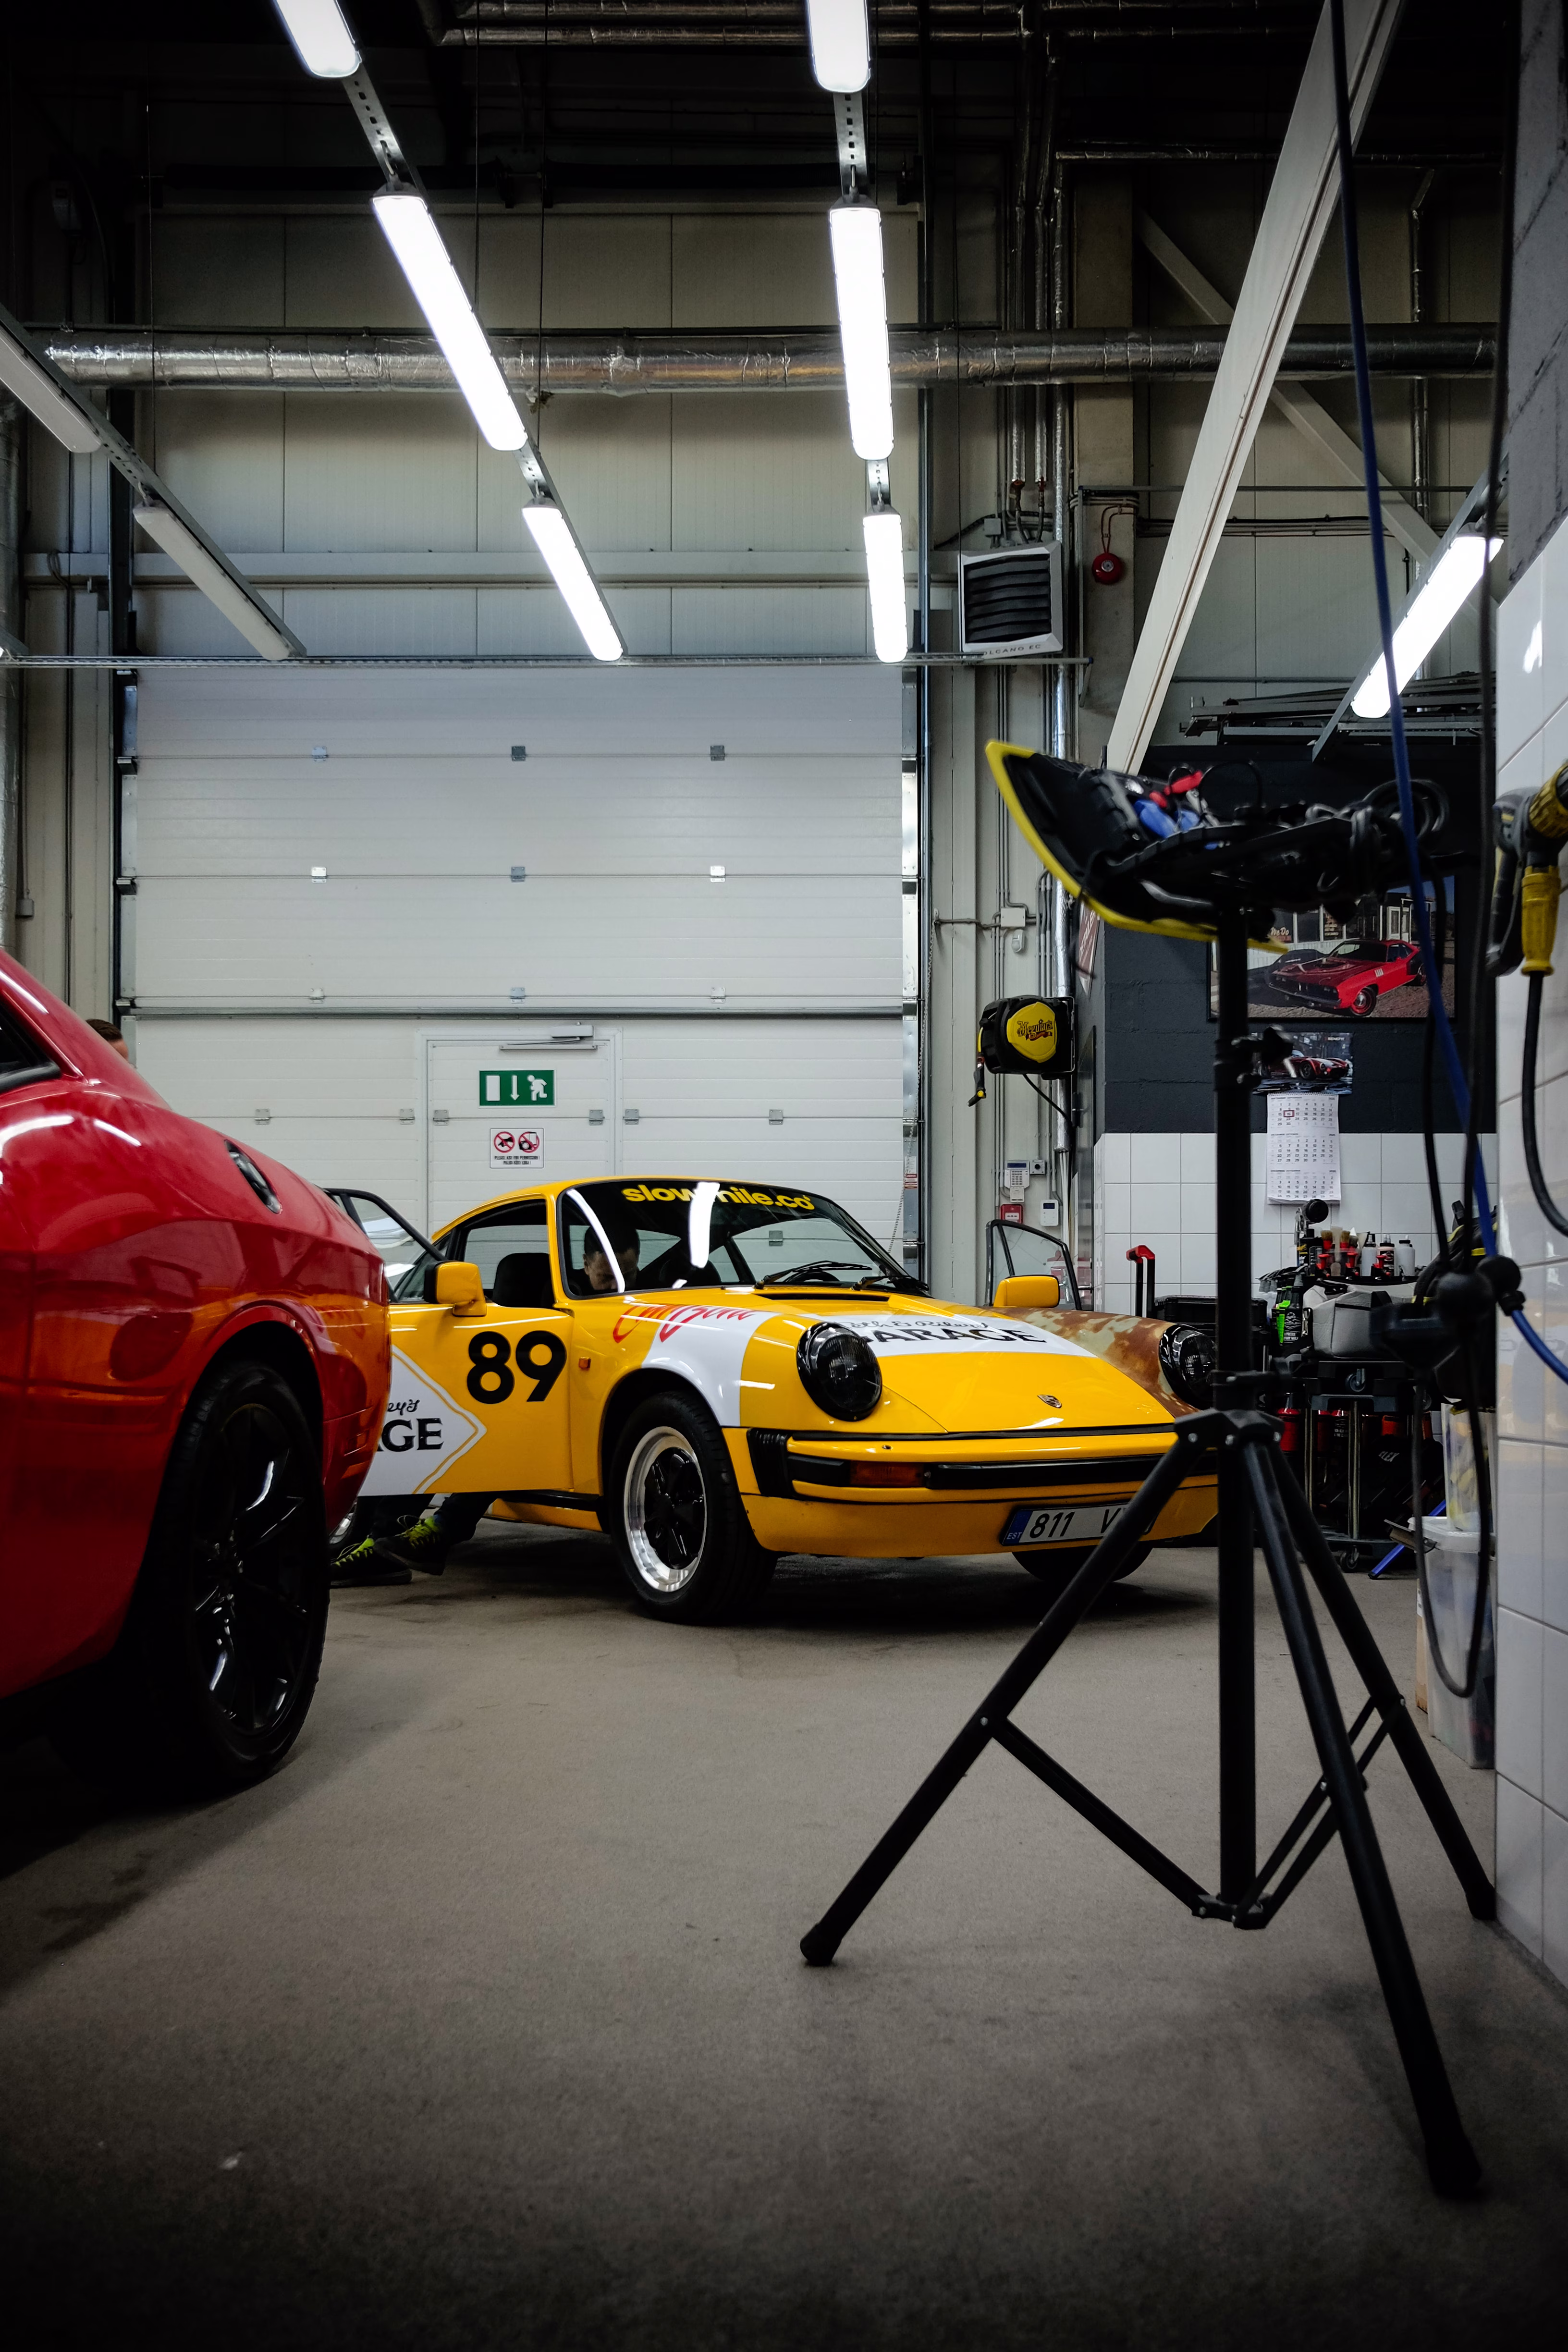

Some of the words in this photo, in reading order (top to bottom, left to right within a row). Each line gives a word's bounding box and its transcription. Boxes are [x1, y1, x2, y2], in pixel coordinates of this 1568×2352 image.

[981, 646, 1024, 655] OLCANO
[1016, 1018, 1054, 1038] Meguiar's
[861, 1328, 1047, 1343] ARAGE
[466, 1329, 567, 1405] 89
[387, 1399, 420, 1416] ey's
[376, 1418, 445, 1452] GE
[1029, 1511, 1075, 1539] 811
[1006, 1531, 1023, 1540] EST
